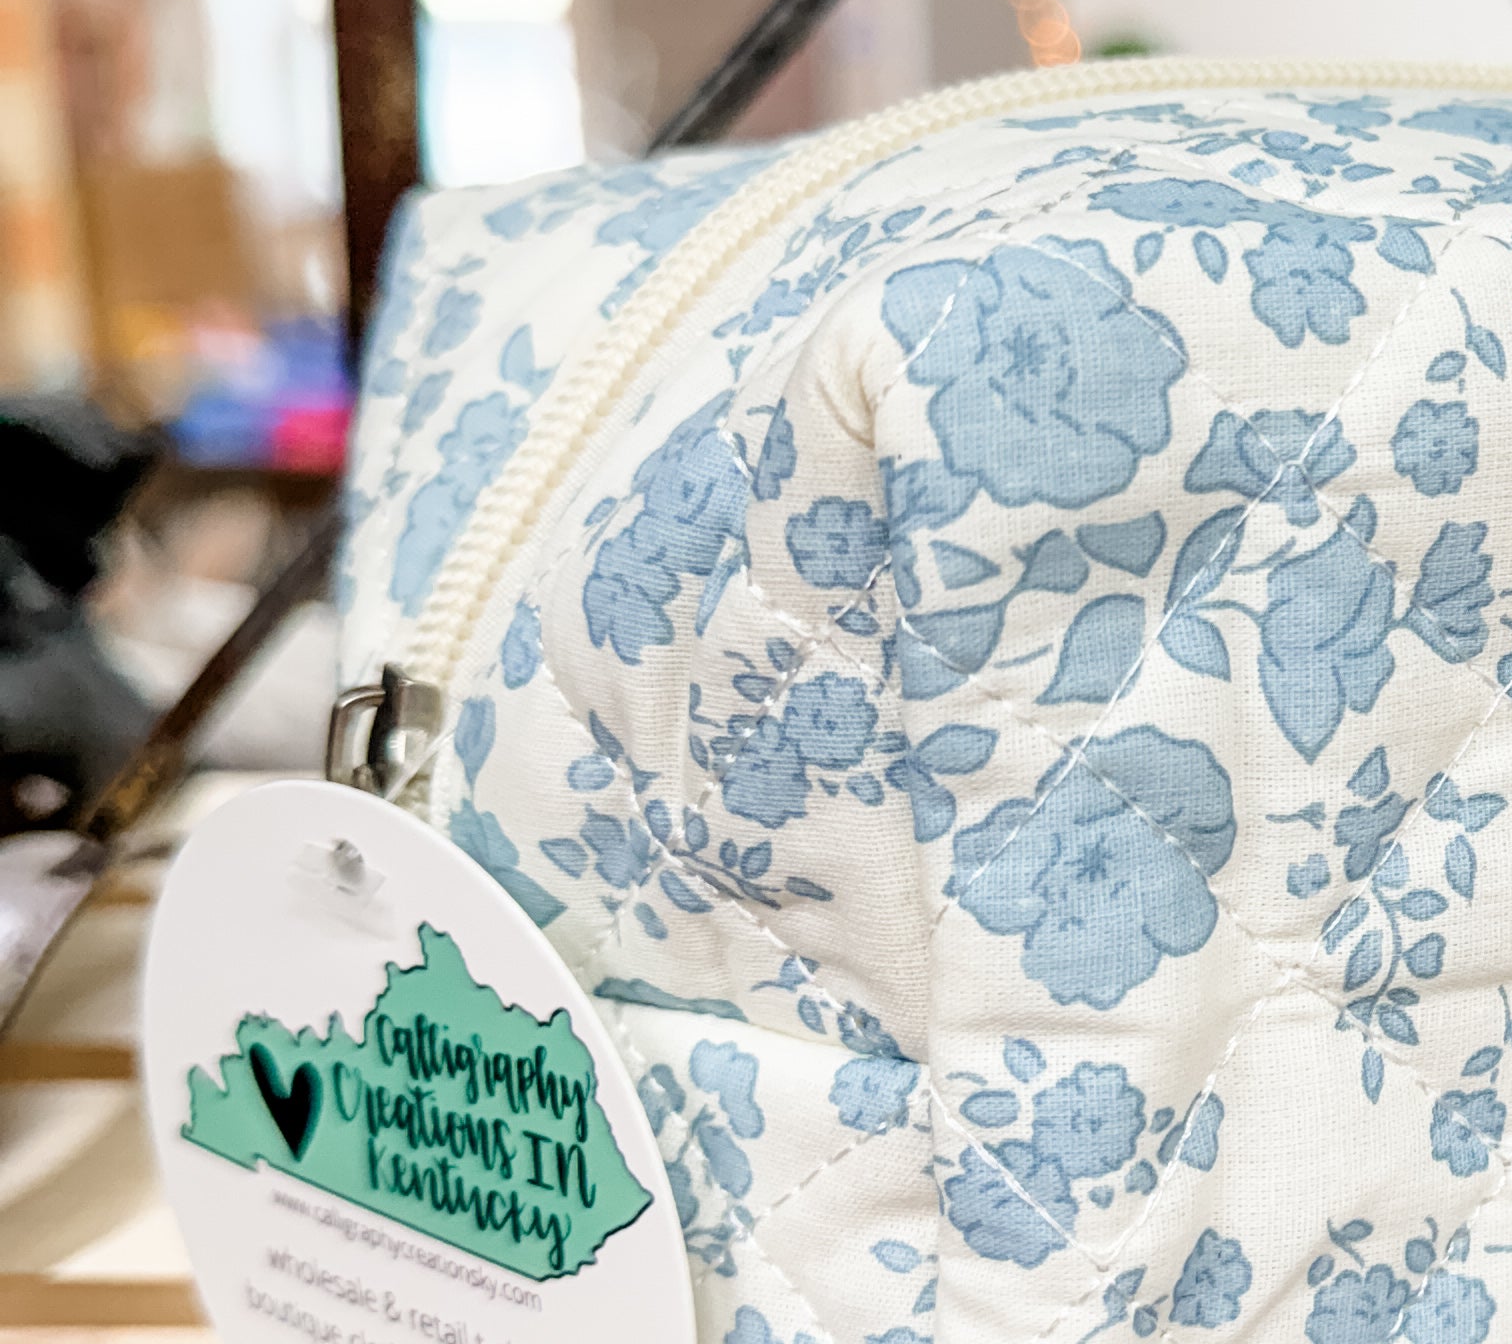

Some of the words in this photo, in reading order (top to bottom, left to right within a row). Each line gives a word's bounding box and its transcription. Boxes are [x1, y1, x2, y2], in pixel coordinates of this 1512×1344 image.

[333, 1061, 516, 1179] Creations
[375, 1013, 590, 1142] Calligraphy
[366, 1136, 572, 1270] Kentucky
[383, 1290, 402, 1322] &
